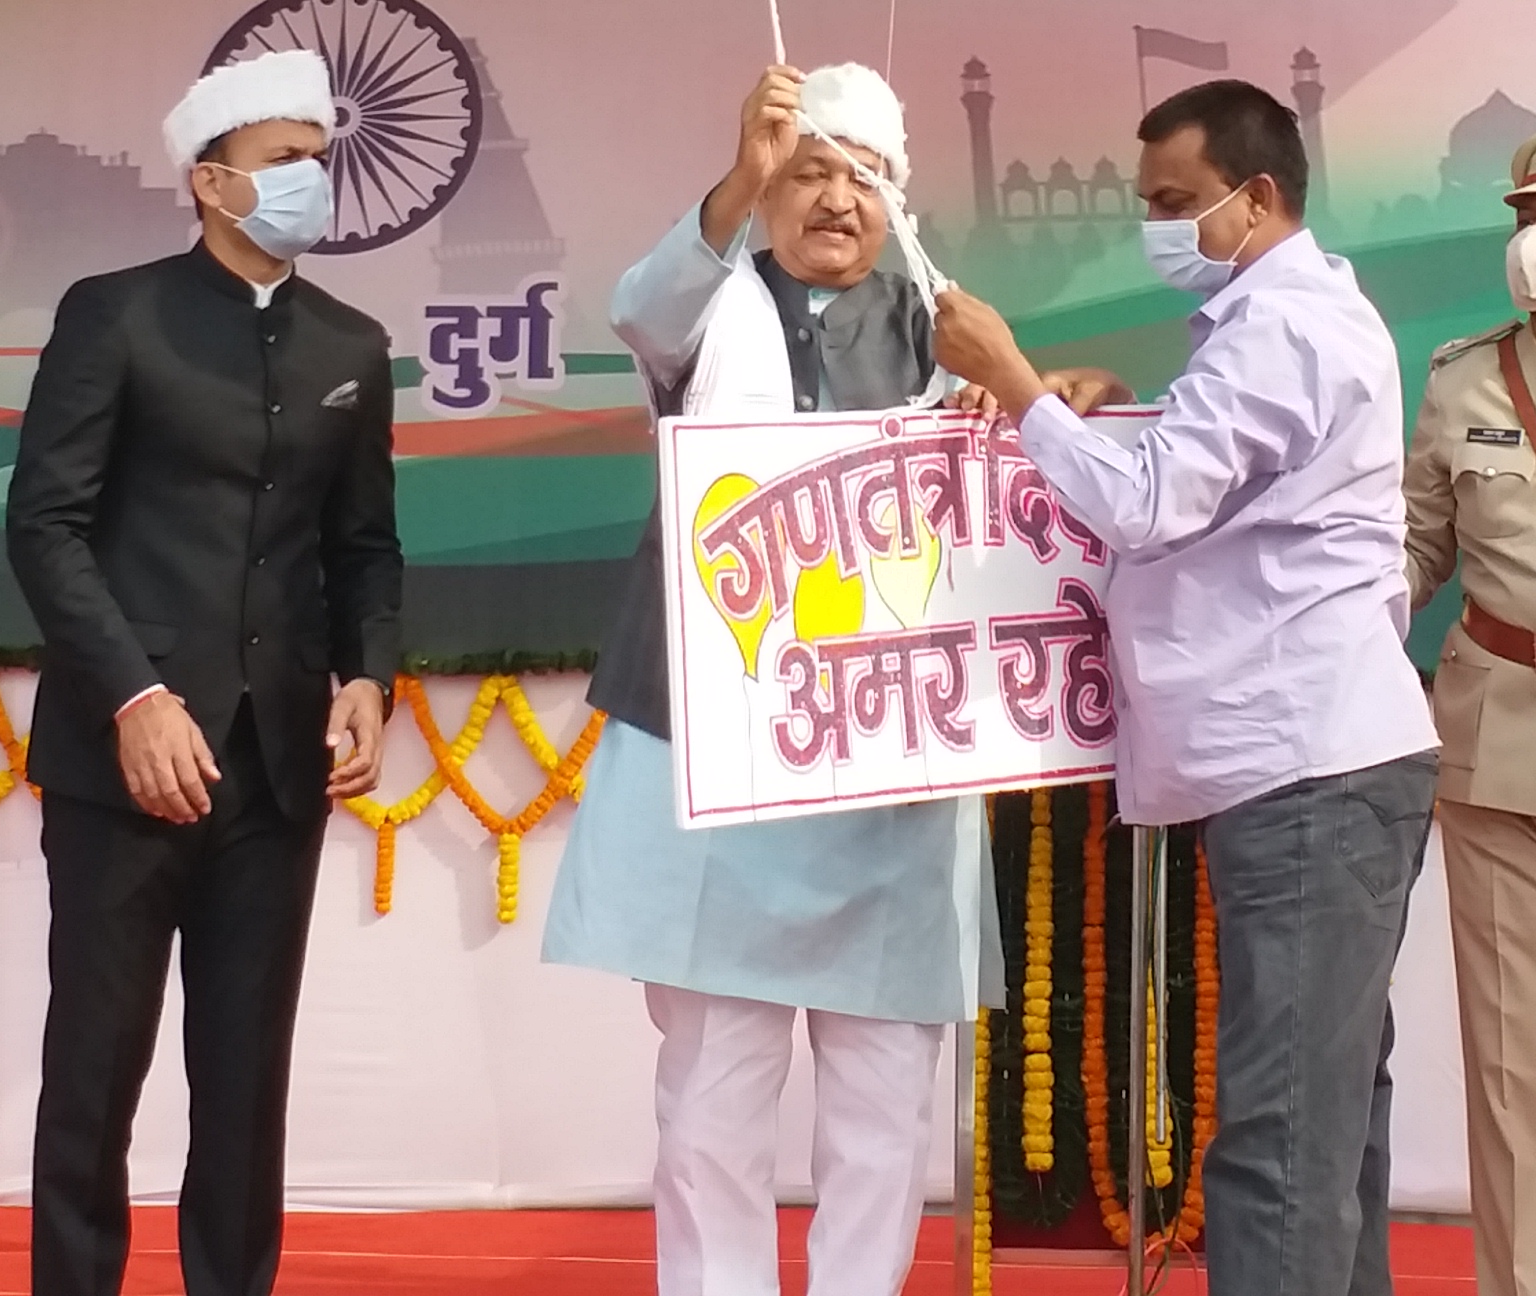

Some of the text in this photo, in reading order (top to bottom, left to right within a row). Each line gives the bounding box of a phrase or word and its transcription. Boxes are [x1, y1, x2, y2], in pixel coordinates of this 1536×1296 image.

[425, 282, 559, 408] दुर्ग
[698, 412, 971, 622] गणतंत्र
[769, 577, 1119, 775] अमर रहे
